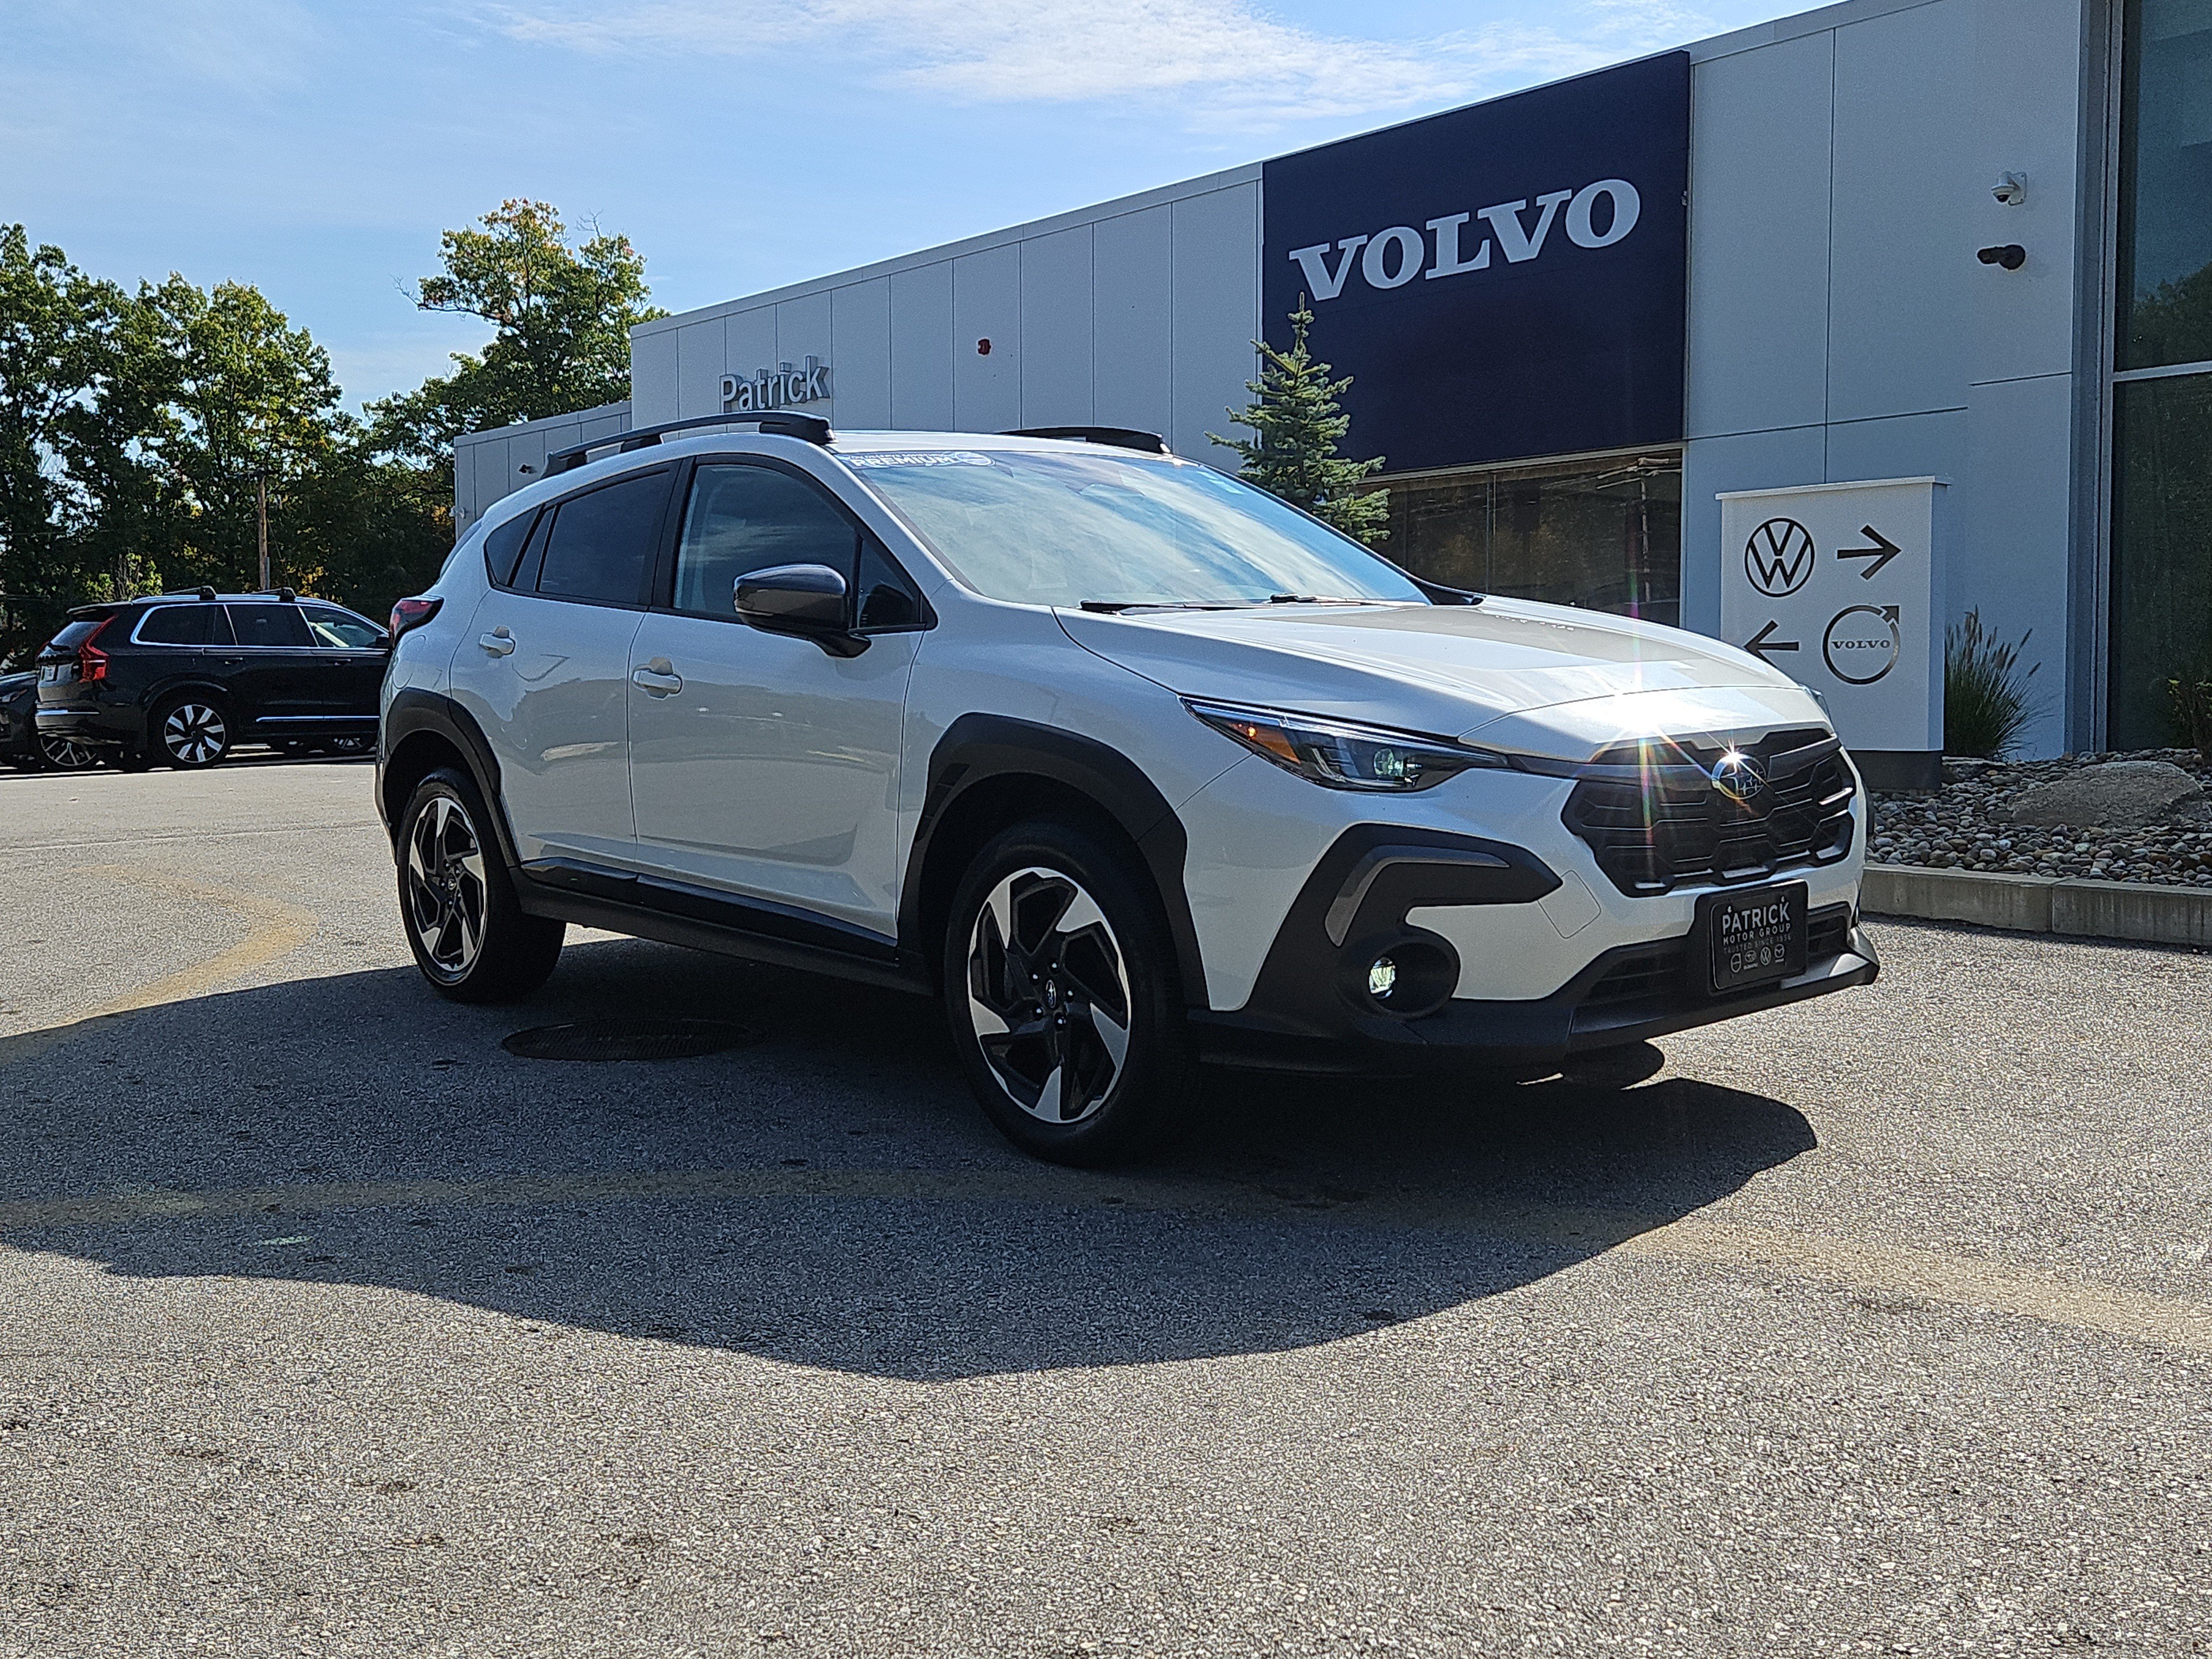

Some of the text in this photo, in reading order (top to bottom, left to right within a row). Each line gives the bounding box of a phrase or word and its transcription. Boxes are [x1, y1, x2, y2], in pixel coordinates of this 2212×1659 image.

[1289, 178, 1641, 302] VOLVO
[719, 355, 827, 414] Patrick
[851, 456, 957, 467] PREMIUM
[1831, 639, 1891, 650] VOLVO
[1722, 901, 1790, 935] PATRICK
[1723, 923, 1791, 946] MOTOR GROUP
